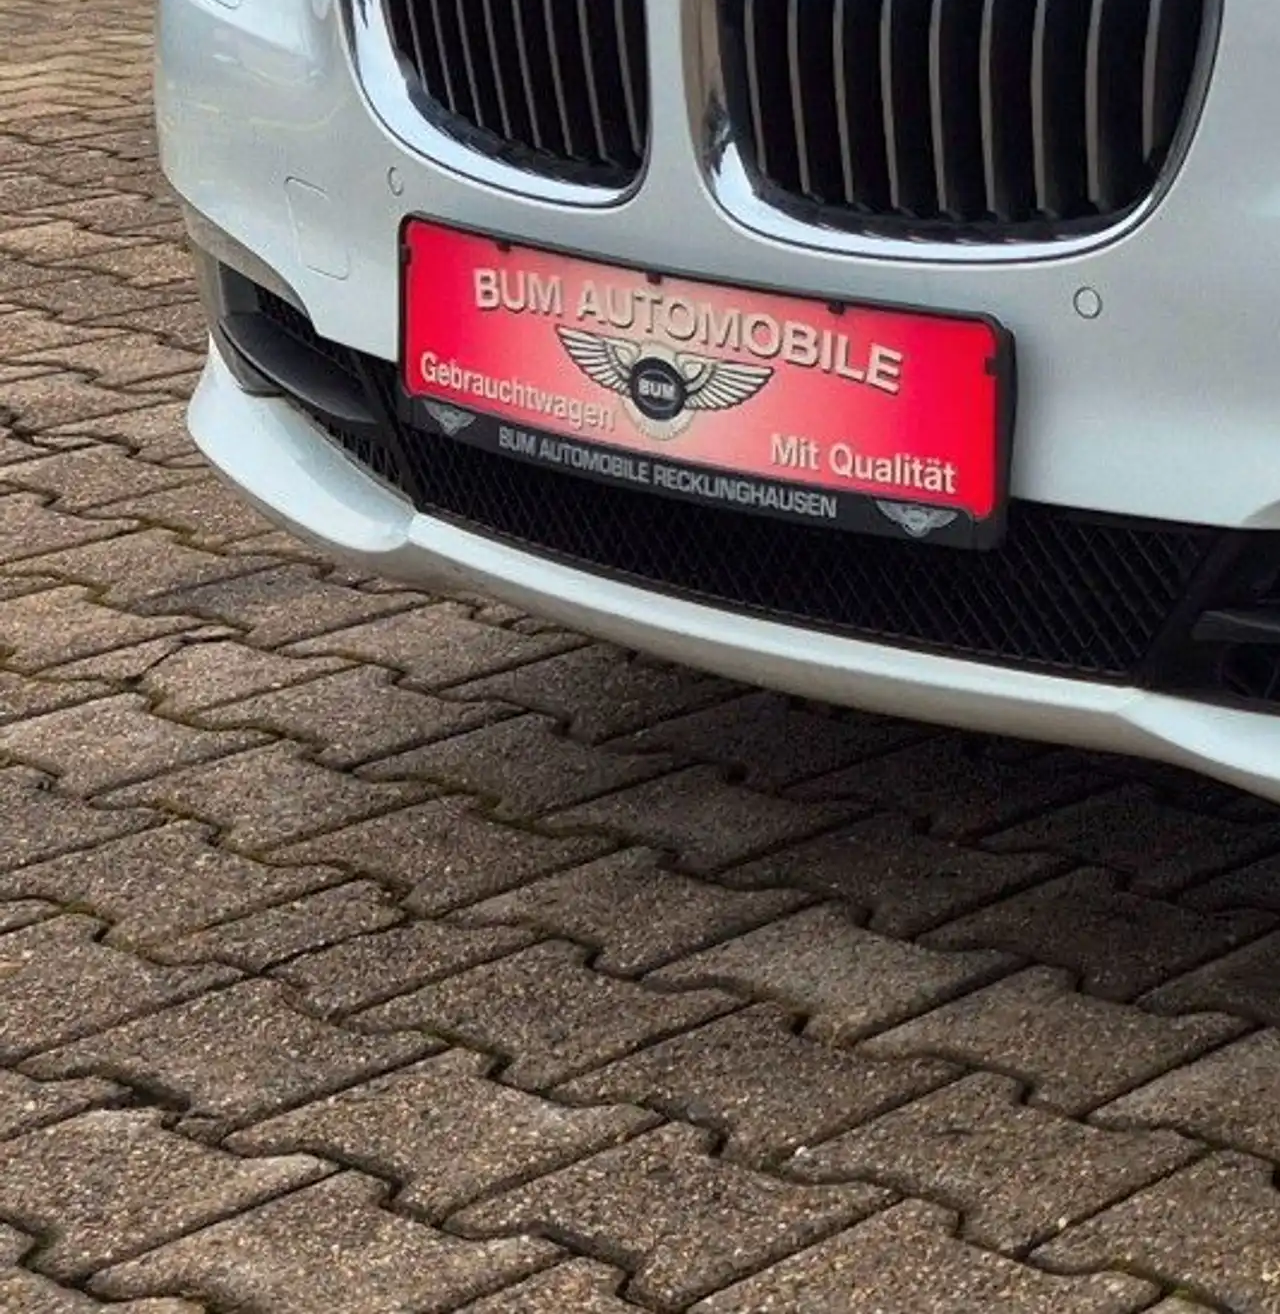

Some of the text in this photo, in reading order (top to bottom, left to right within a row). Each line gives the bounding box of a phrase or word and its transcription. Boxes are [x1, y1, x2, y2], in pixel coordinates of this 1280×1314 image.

[473, 268, 903, 395] BUM AUTOMOBILE
[420, 351, 616, 433] Gebrauchtwagen
[638, 378, 675, 397] BUM
[498, 426, 837, 519] BUM AUTOMOBILE RECKLINGHAUSEN
[770, 433, 957, 495] Mit Qualität
